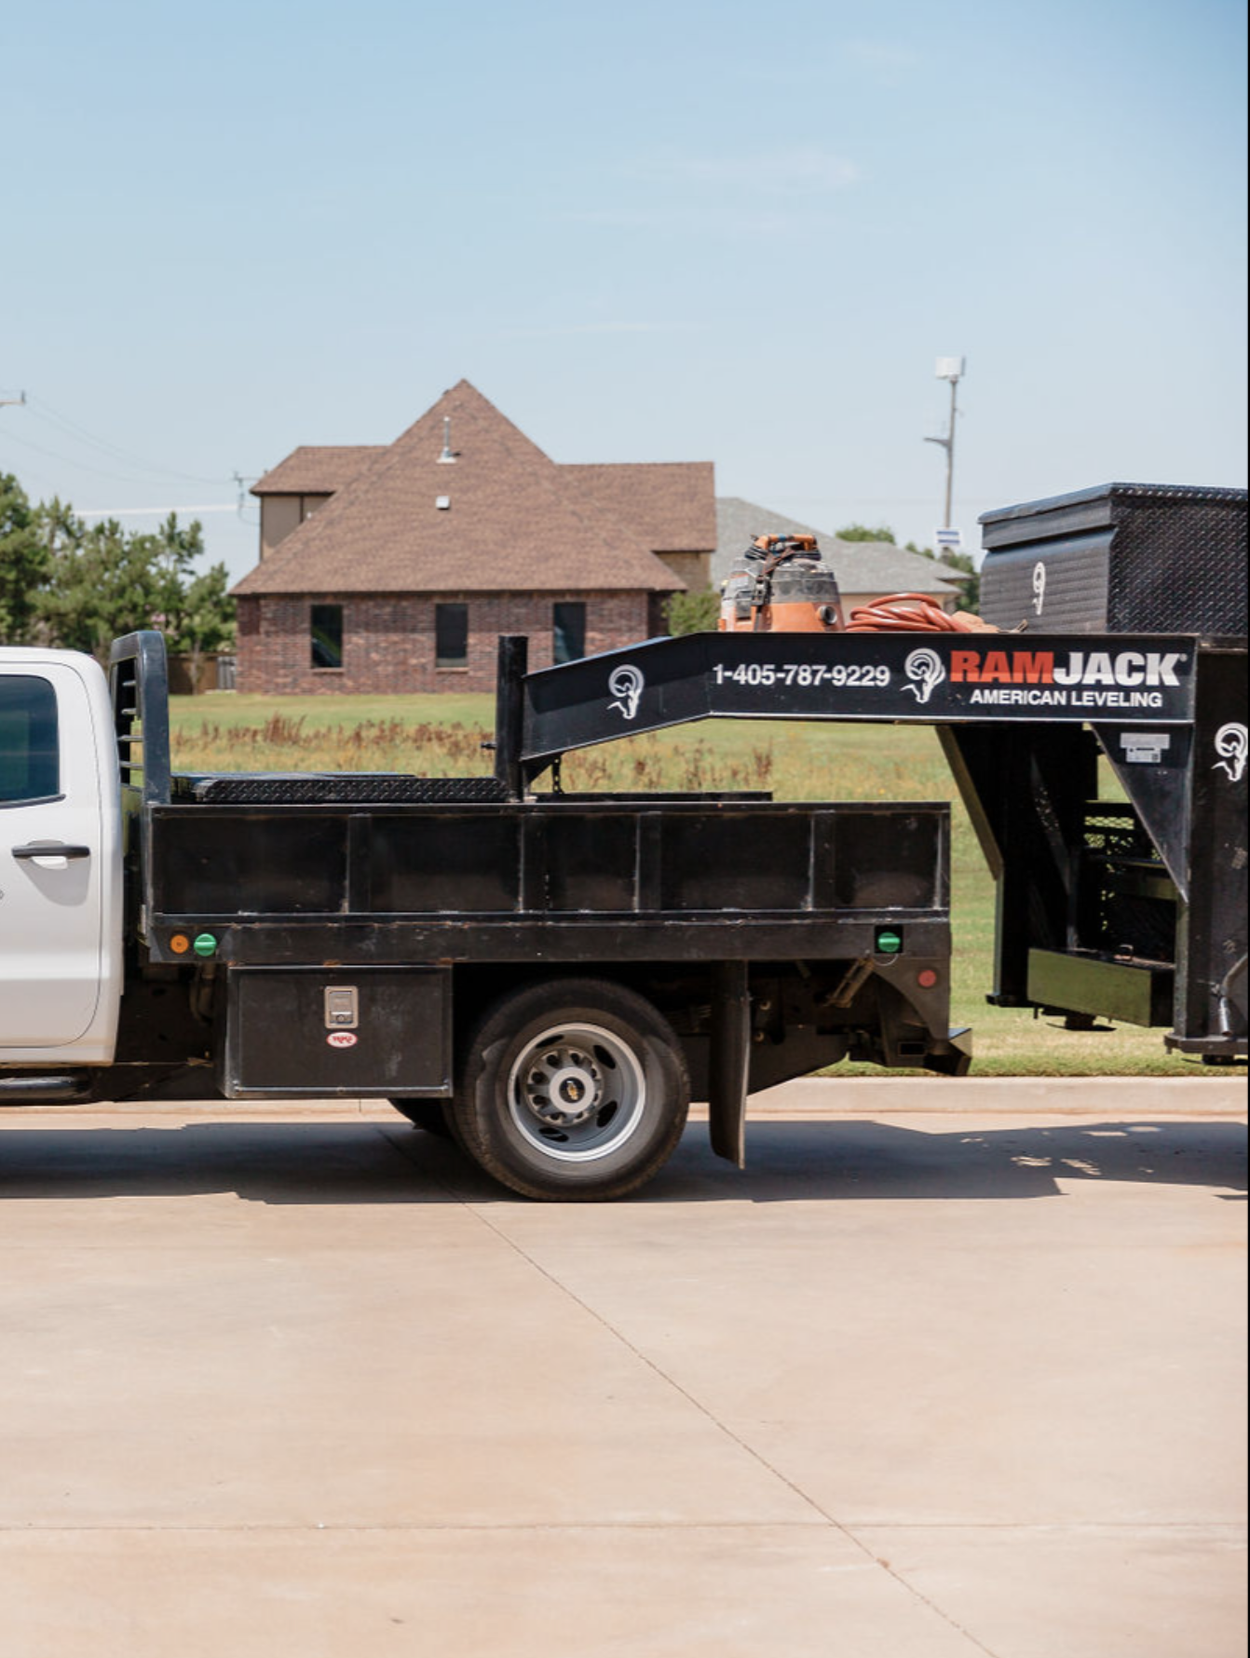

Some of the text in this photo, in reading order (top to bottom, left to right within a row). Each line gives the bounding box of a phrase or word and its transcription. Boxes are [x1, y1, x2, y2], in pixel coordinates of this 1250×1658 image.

[712, 664, 891, 687] 1-405-787-9229
[969, 688, 1163, 707] AMERICAN LEVELING
